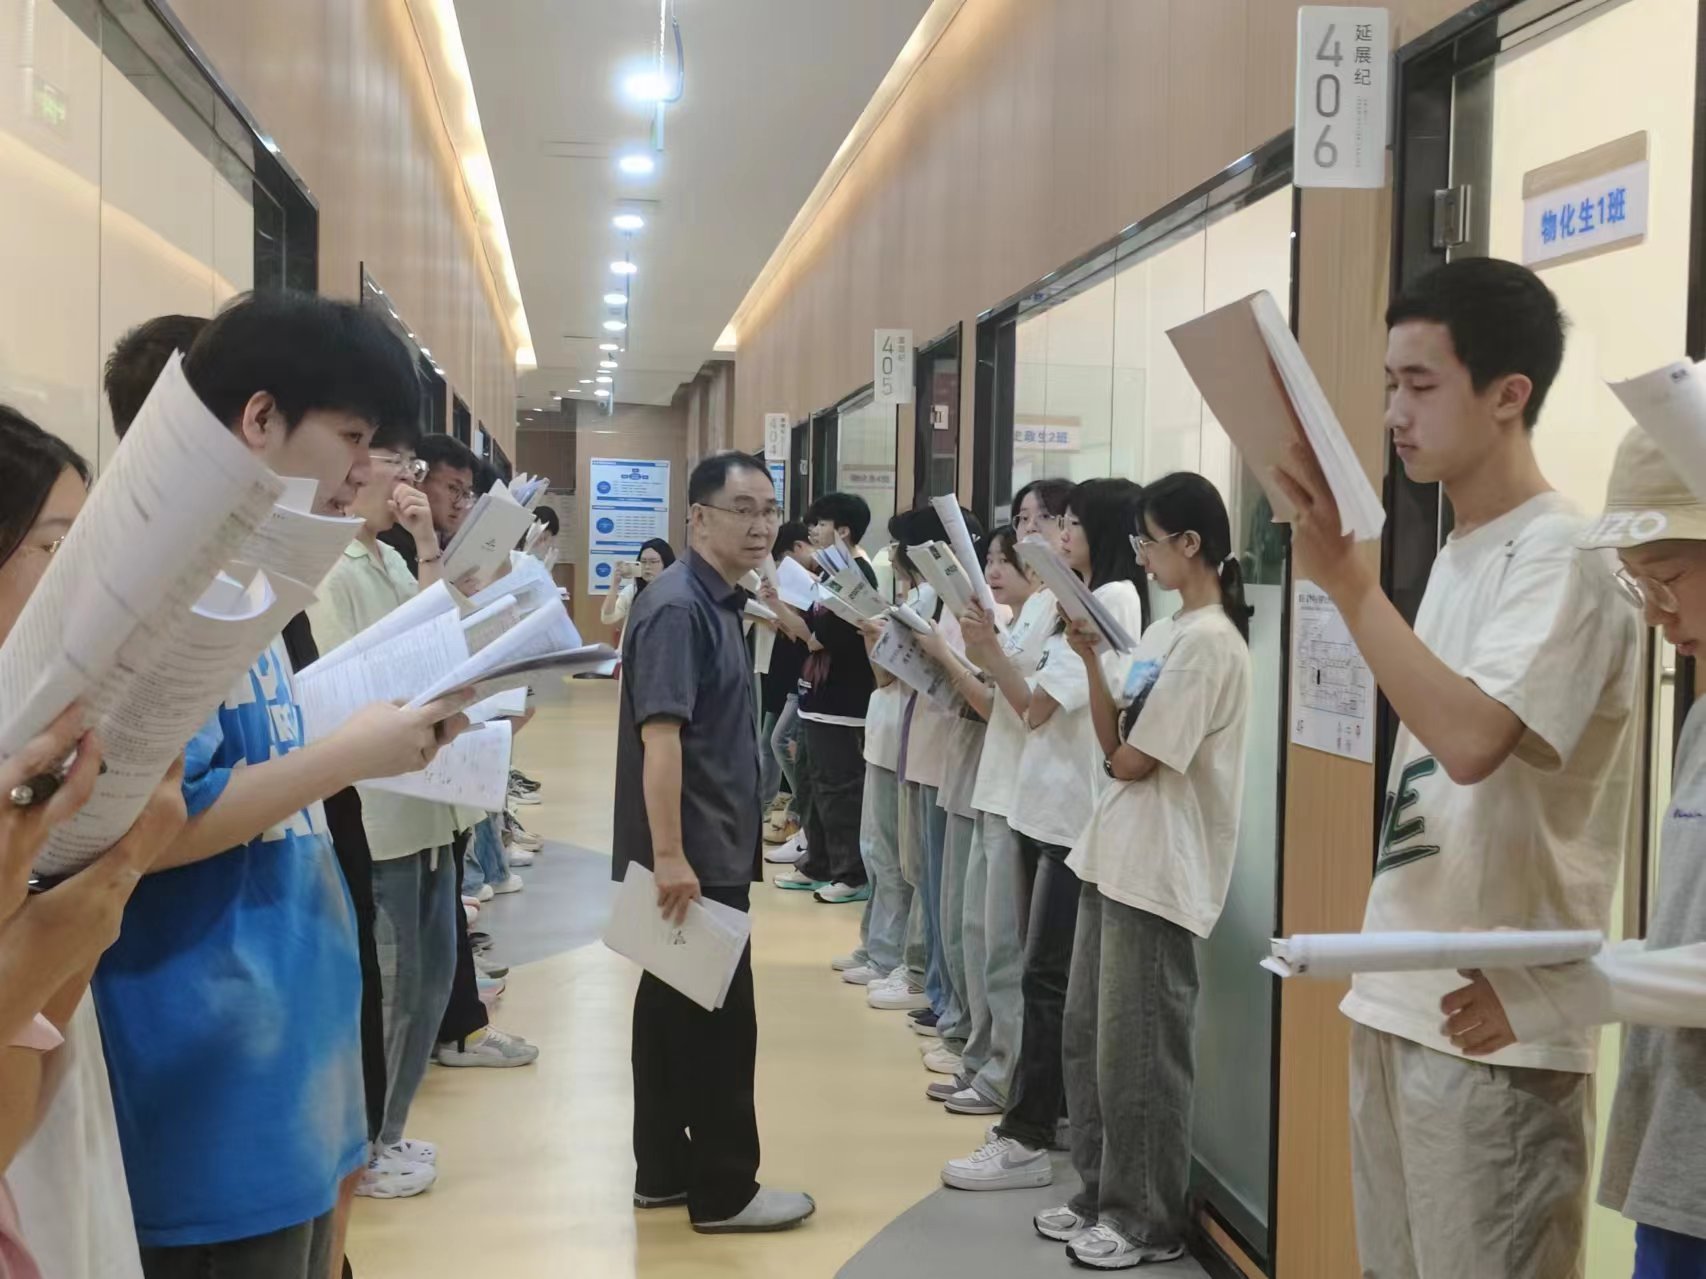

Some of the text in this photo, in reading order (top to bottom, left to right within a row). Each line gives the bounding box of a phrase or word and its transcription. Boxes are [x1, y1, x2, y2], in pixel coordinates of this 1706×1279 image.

[1353, 23, 1373, 87] 延展纪
[1314, 23, 1343, 169] 406
[1541, 187, 1627, 245] 物化生1班
[882, 335, 894, 397] 405
